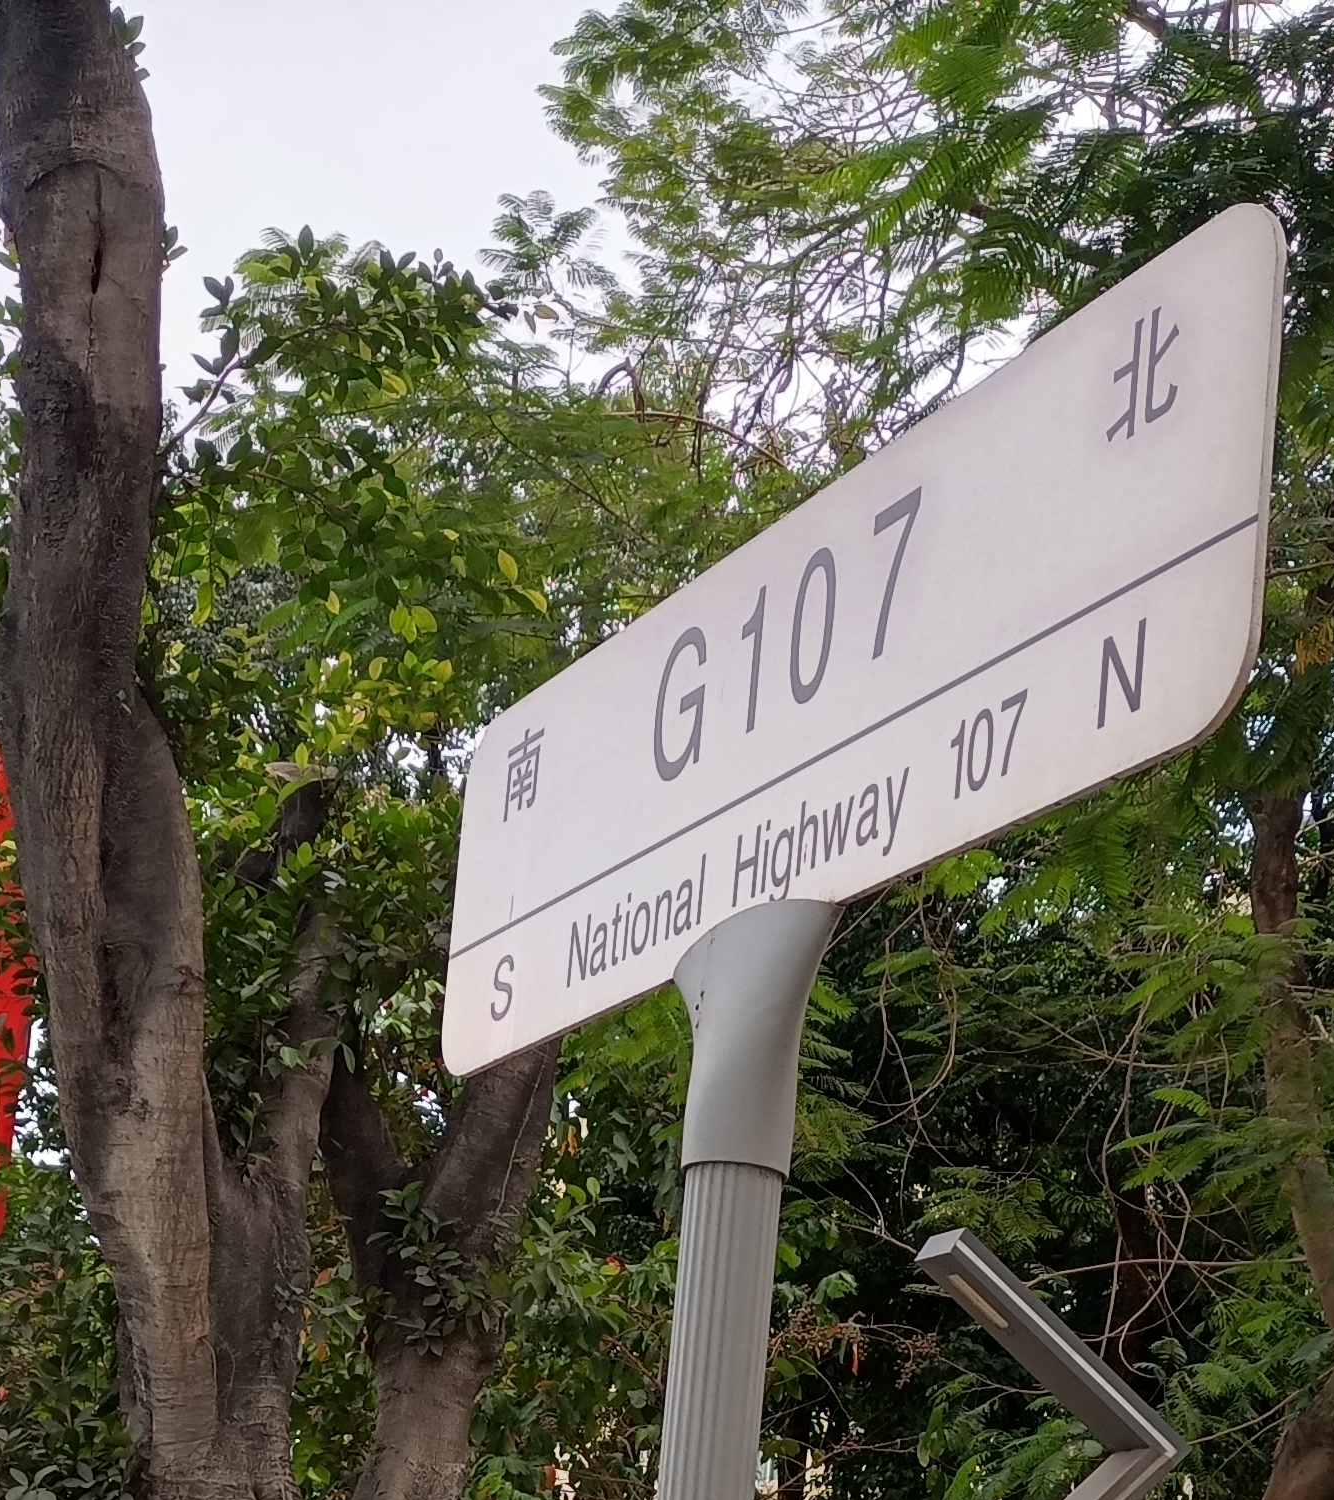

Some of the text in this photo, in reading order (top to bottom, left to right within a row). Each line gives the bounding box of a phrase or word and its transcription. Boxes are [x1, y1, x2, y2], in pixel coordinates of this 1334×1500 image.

[1105, 305, 1181, 443] 北
[652, 486, 923, 783] G107
[489, 618, 1148, 1023] S National Highway 107 N
[502, 727, 546, 823] 南
